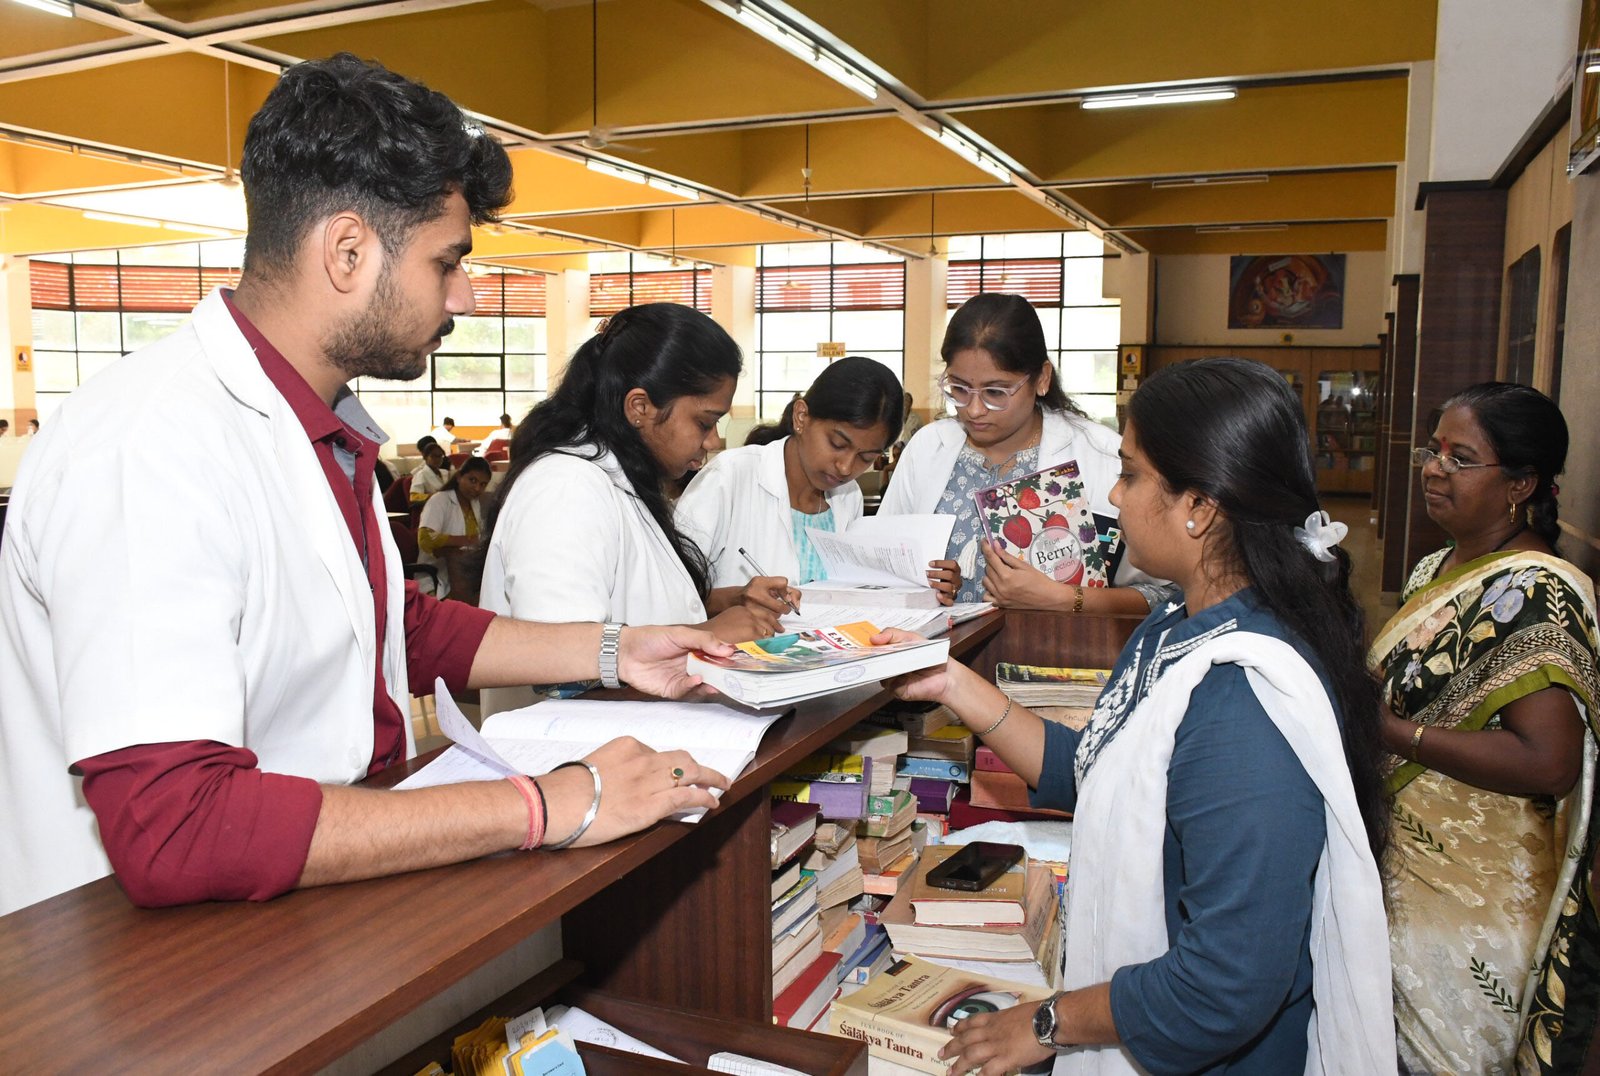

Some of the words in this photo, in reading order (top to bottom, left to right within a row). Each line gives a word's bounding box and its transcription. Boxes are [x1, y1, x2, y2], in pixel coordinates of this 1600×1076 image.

[1036, 544, 1073, 565] Berry
[899, 974, 930, 992] Tantra
[839, 1020, 882, 1046] Śālākya
[885, 1037, 924, 1060] Tantra
